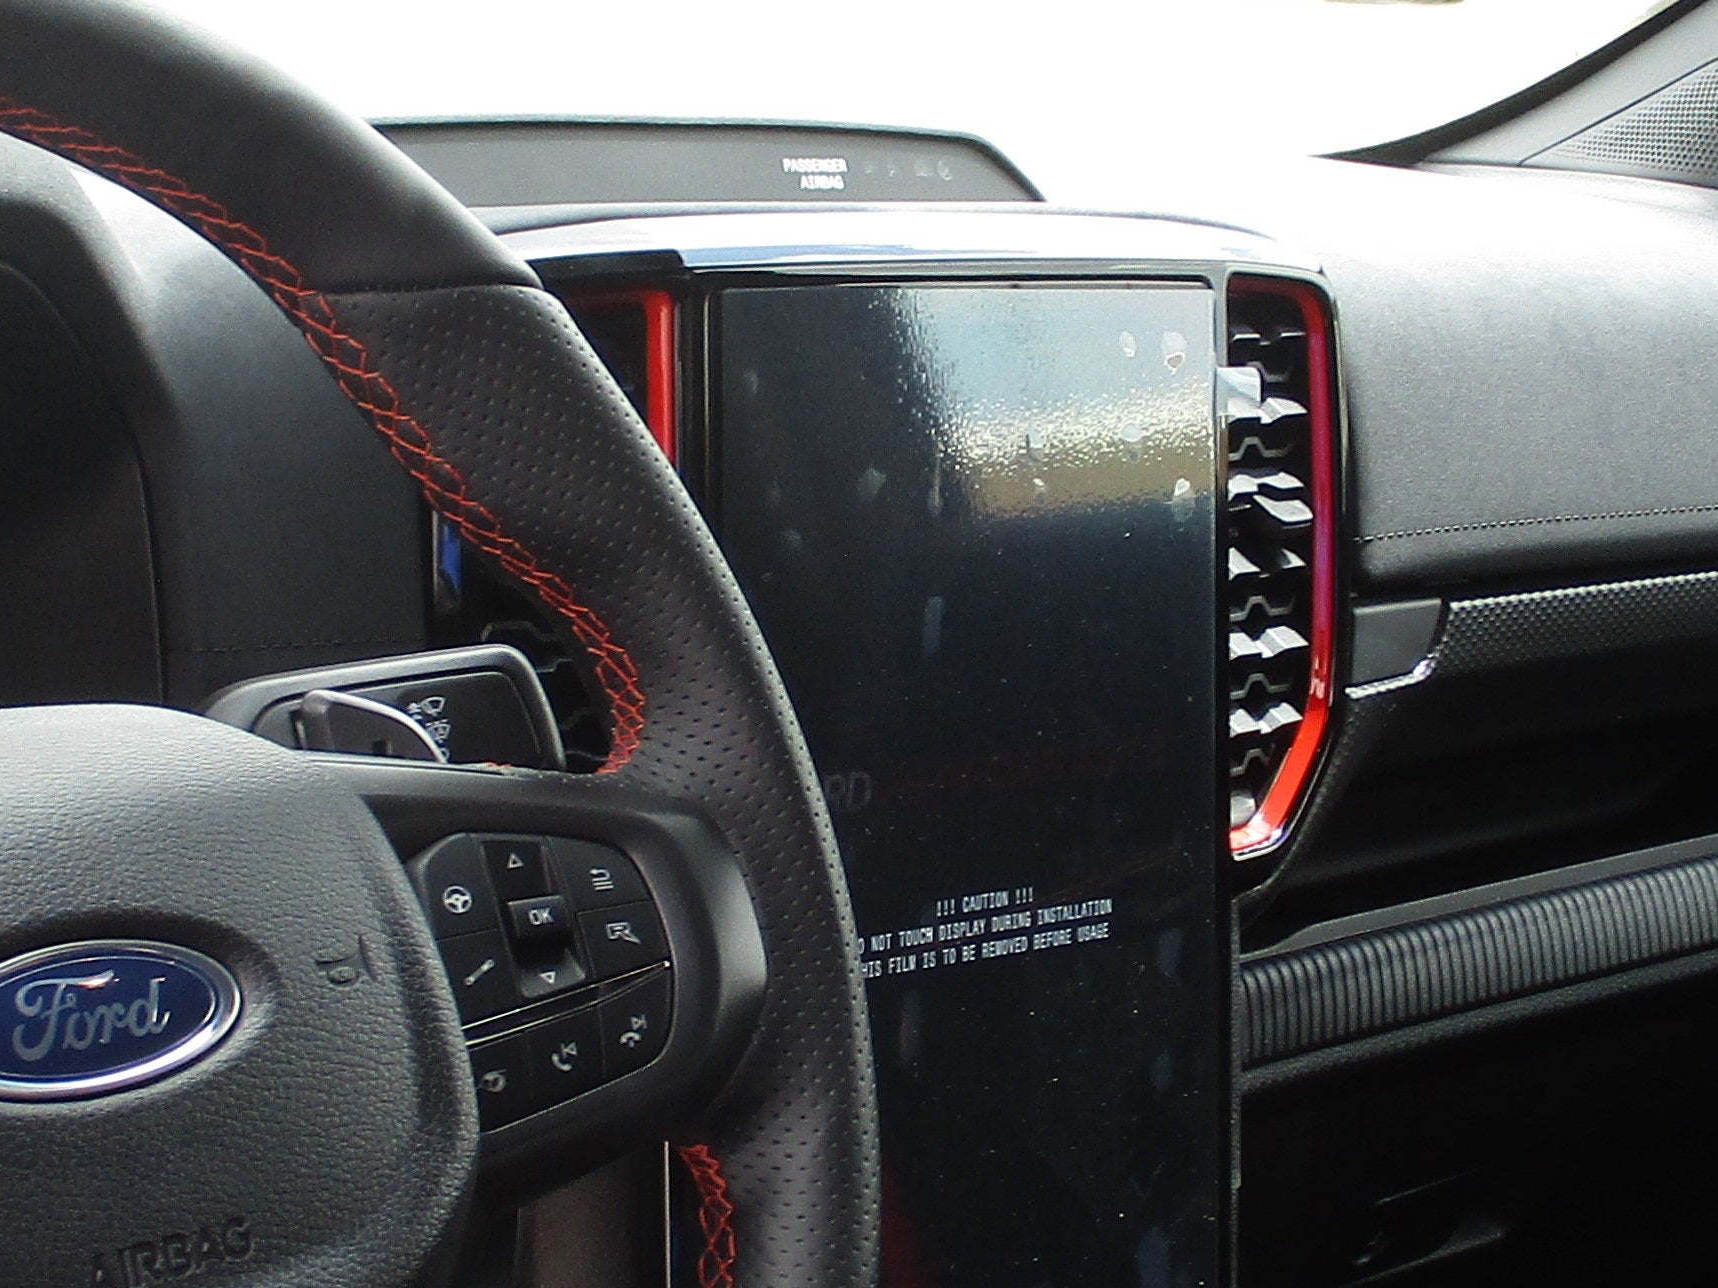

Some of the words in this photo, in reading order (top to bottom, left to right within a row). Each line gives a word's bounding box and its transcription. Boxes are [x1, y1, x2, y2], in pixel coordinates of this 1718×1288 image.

[783, 158, 848, 173] PASSENGER
[800, 175, 845, 189] AIRBAG
[962, 890, 1009, 913] CAUTION
[528, 907, 555, 926] OK
[870, 933, 892, 952] NOT
[898, 926, 933, 947] TOUCH
[938, 918, 986, 942] DISPLAY
[991, 911, 1031, 932] DURING
[1037, 898, 1112, 925] INSTALLATION
[888, 954, 916, 974] FILM
[923, 951, 936, 969] IS
[942, 947, 956, 965] TO
[962, 944, 975, 962] BE
[982, 936, 1028, 959] REMOVED
[1033, 928, 1072, 950] BEFORE
[1078, 922, 1109, 942] USAGE
[12, 969, 170, 1061] Ford
